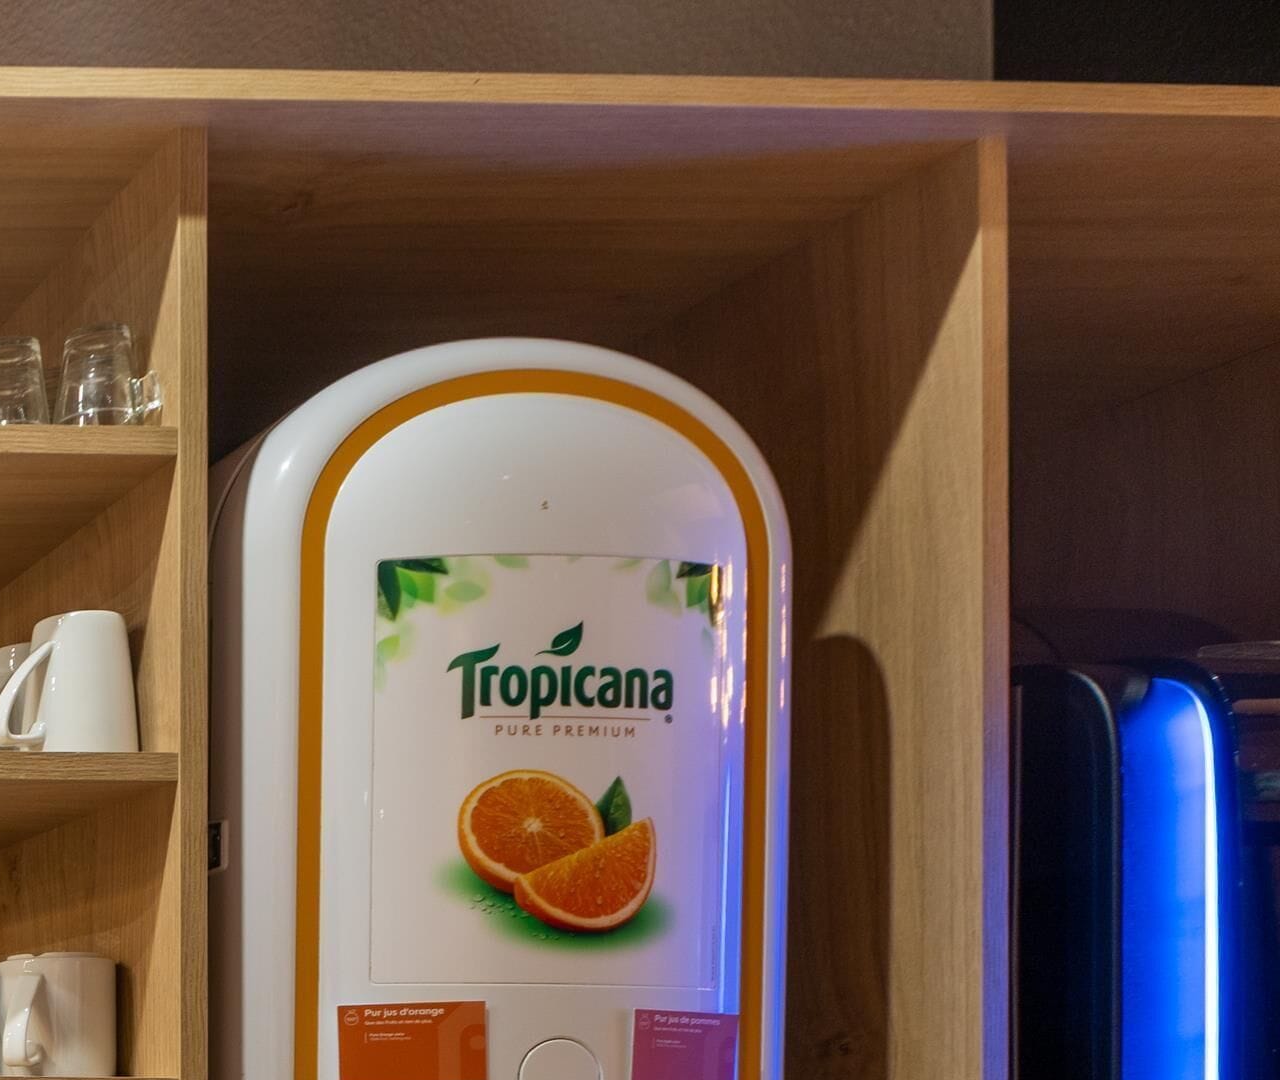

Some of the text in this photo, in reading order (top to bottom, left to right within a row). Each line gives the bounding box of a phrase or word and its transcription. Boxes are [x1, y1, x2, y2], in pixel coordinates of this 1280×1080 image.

[446, 643, 674, 720] Tropicana
[495, 724, 637, 738] PURE PREMIUM
[364, 1007, 445, 1019] Pur jus d'orange
